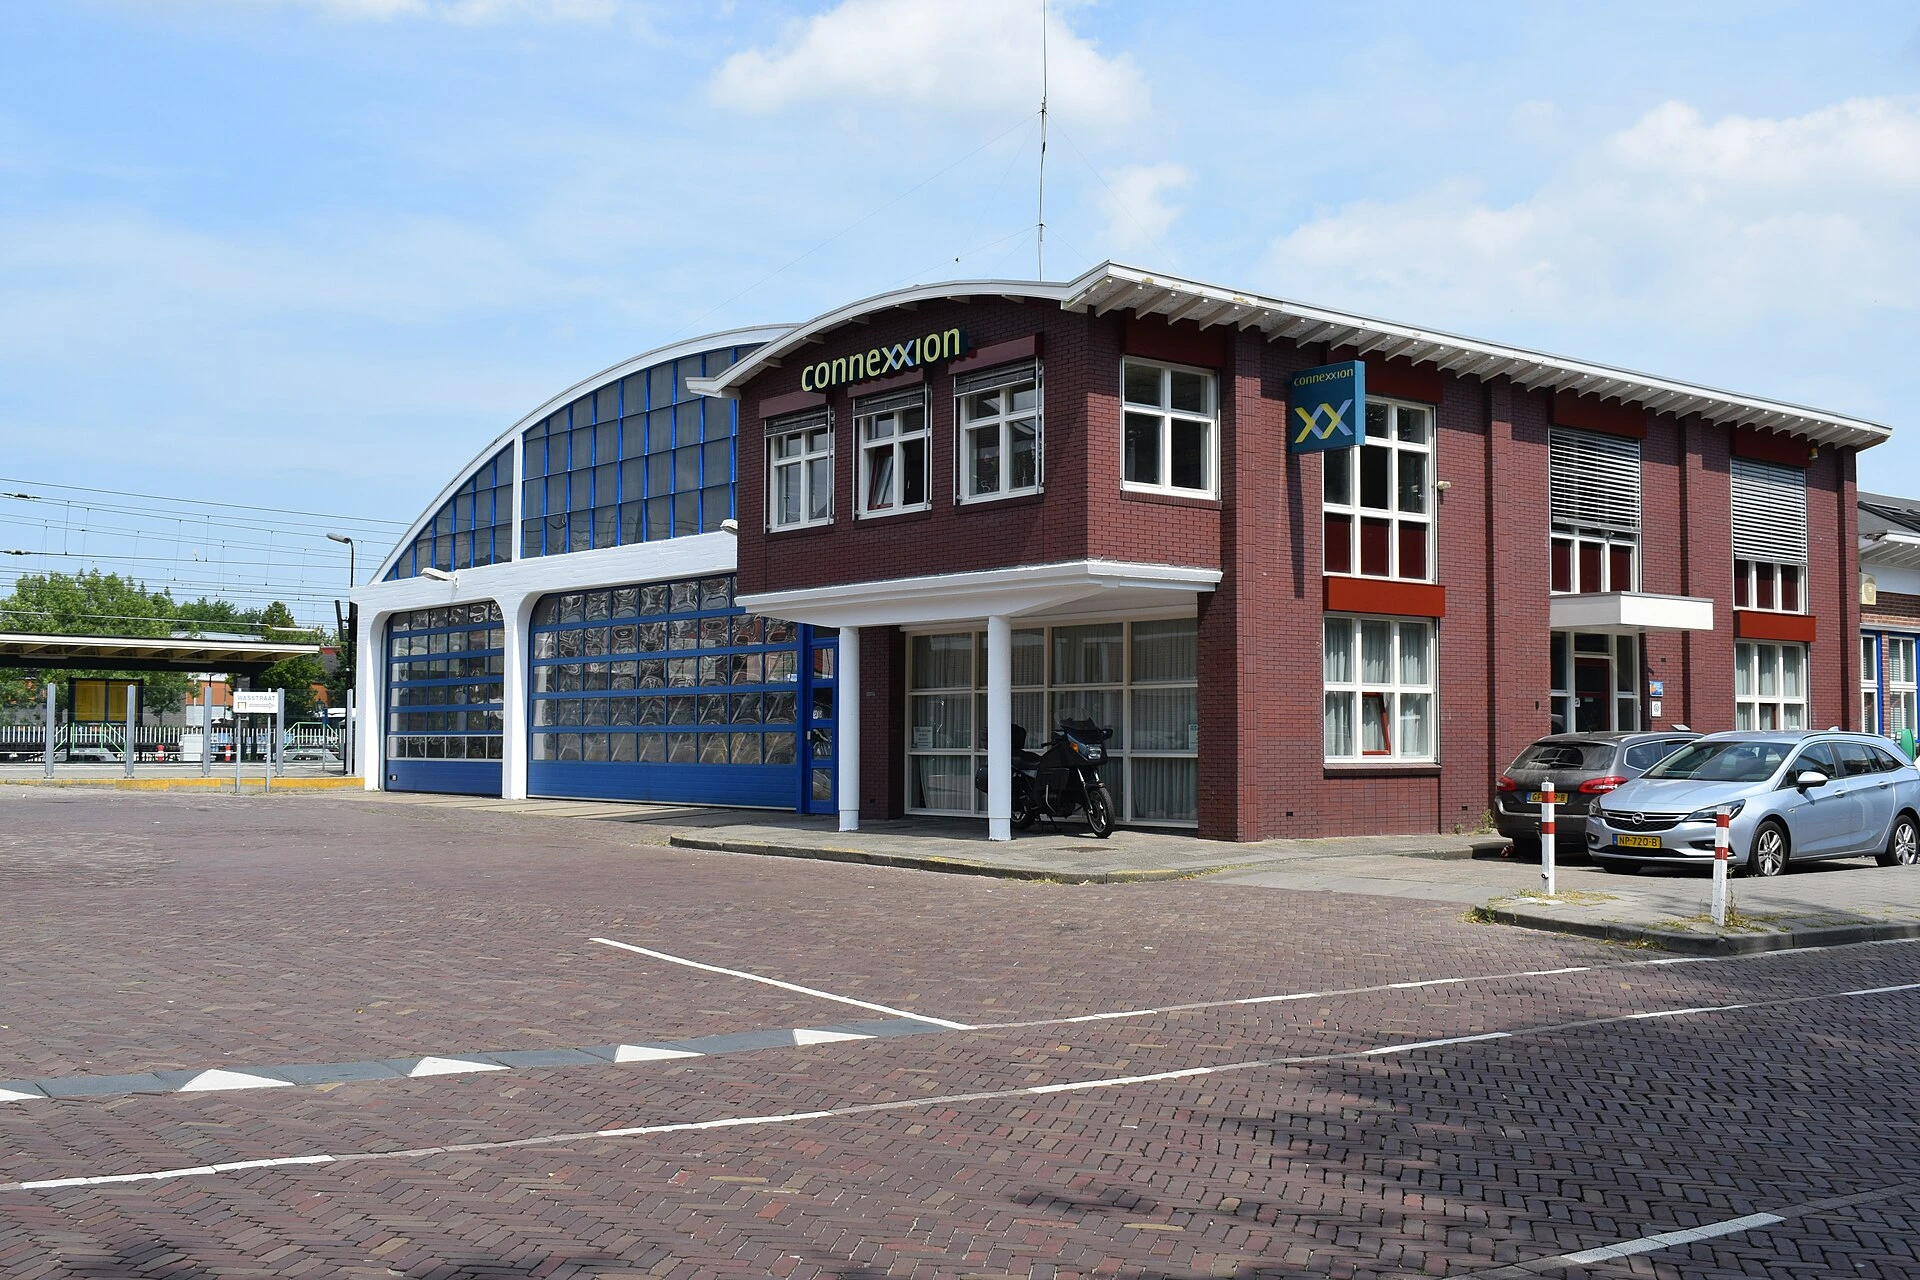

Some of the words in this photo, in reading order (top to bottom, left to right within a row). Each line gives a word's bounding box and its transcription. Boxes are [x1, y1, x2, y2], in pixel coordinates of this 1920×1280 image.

[801, 327, 960, 392] connexxion
[1293, 368, 1354, 387] connexxion
[1619, 836, 1658, 847] NP-720-B
